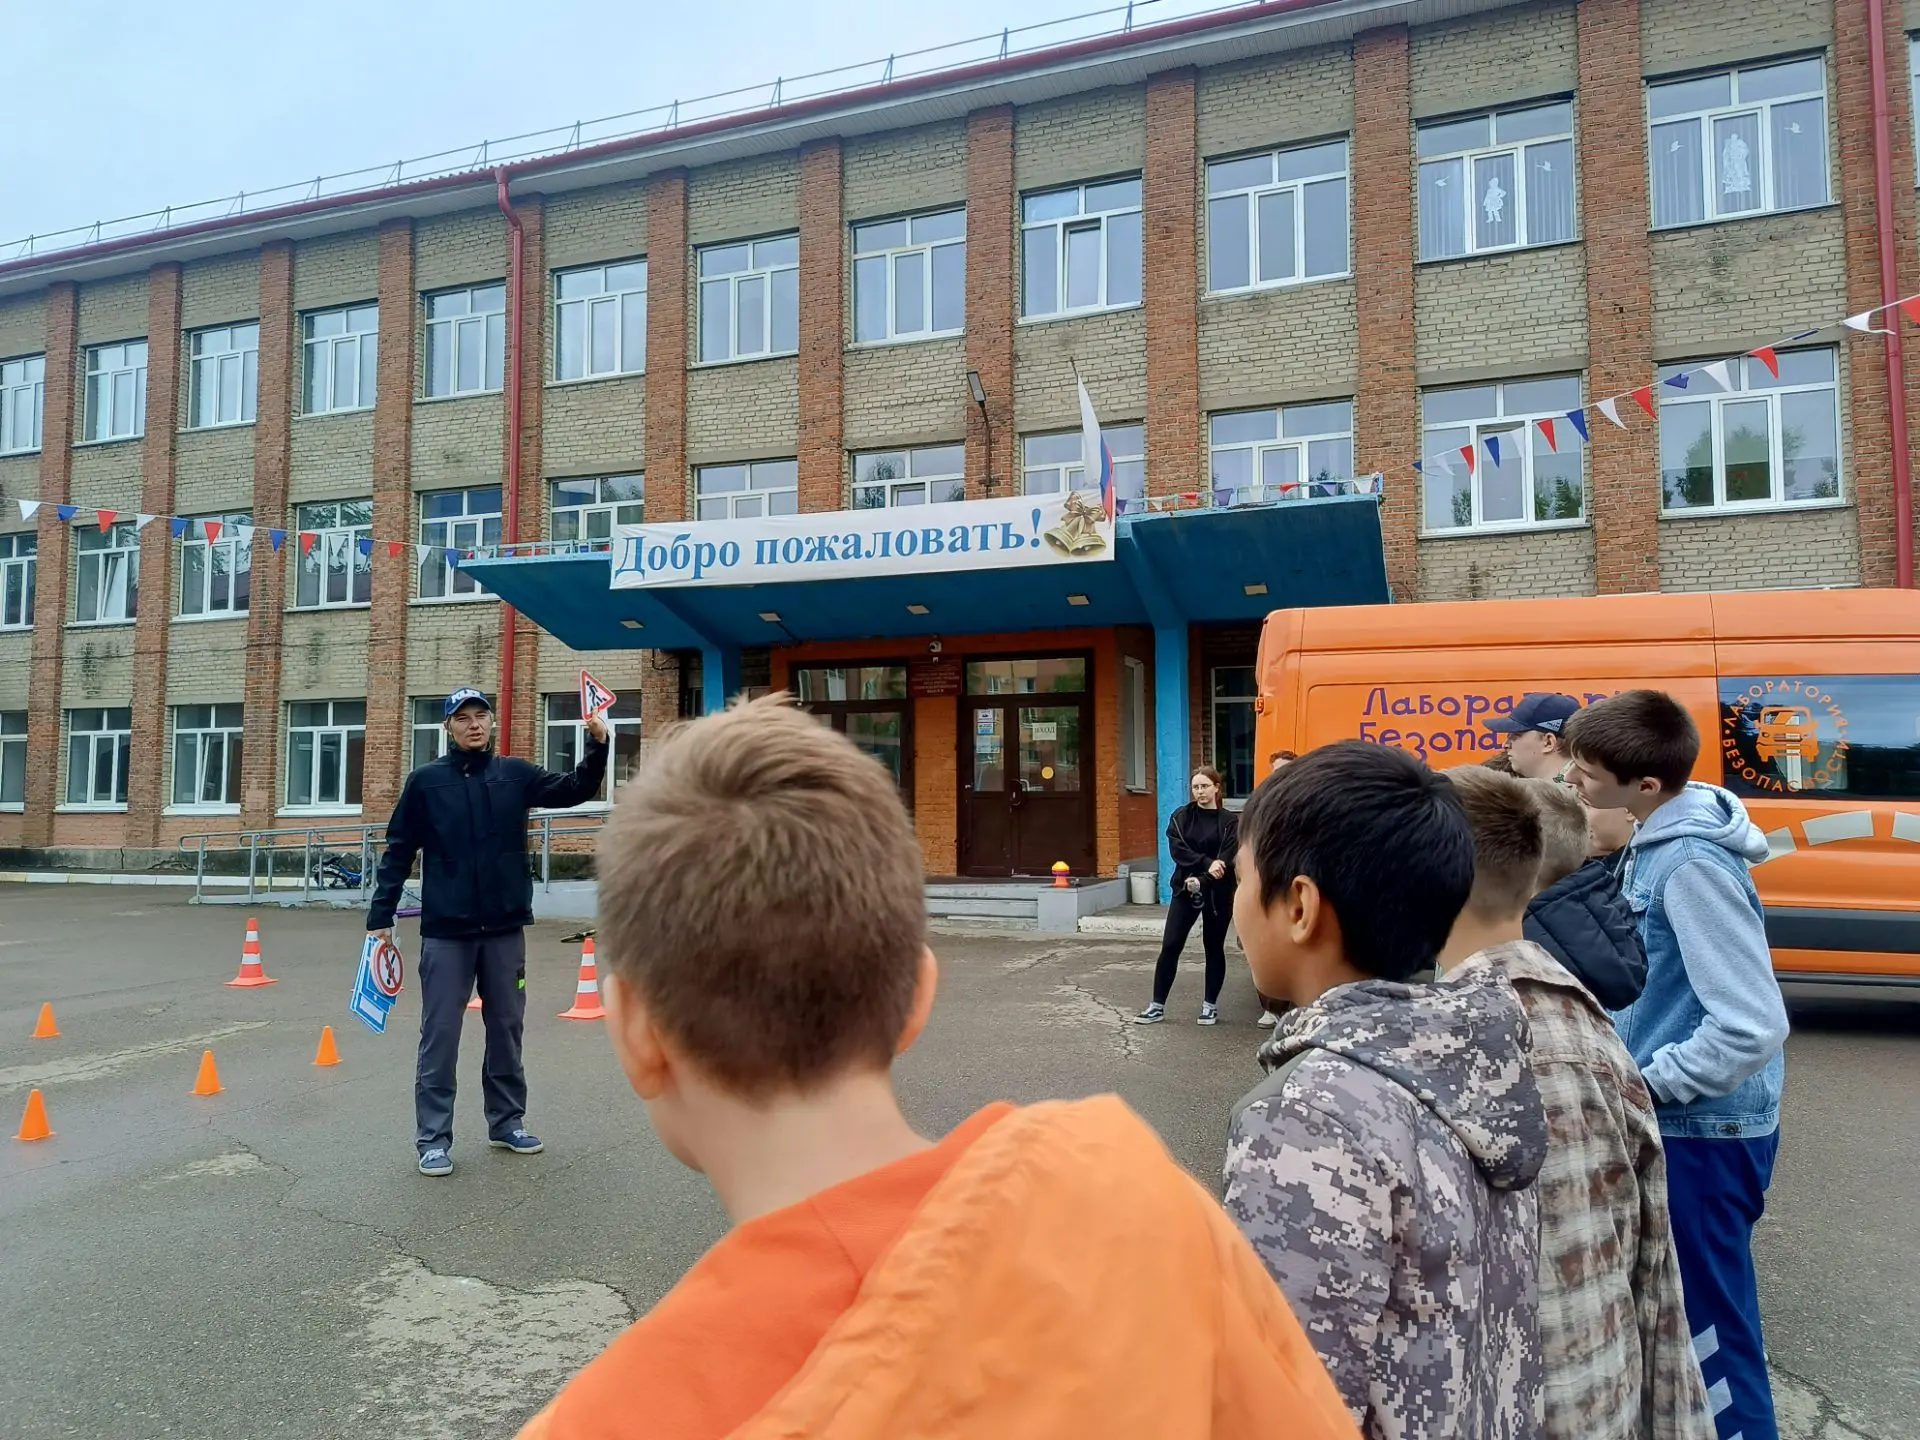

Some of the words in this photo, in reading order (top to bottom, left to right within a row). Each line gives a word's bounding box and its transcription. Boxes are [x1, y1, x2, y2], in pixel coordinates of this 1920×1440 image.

[614, 532, 740, 580] Добро
[754, 508, 1041, 565] пожаловать!
[1362, 687, 1620, 725] Лабора
[1723, 679, 1849, 728] ЛАБОРАТОРИЯ
[1722, 738, 1850, 793] БЕЗОПАСНОСТИ
